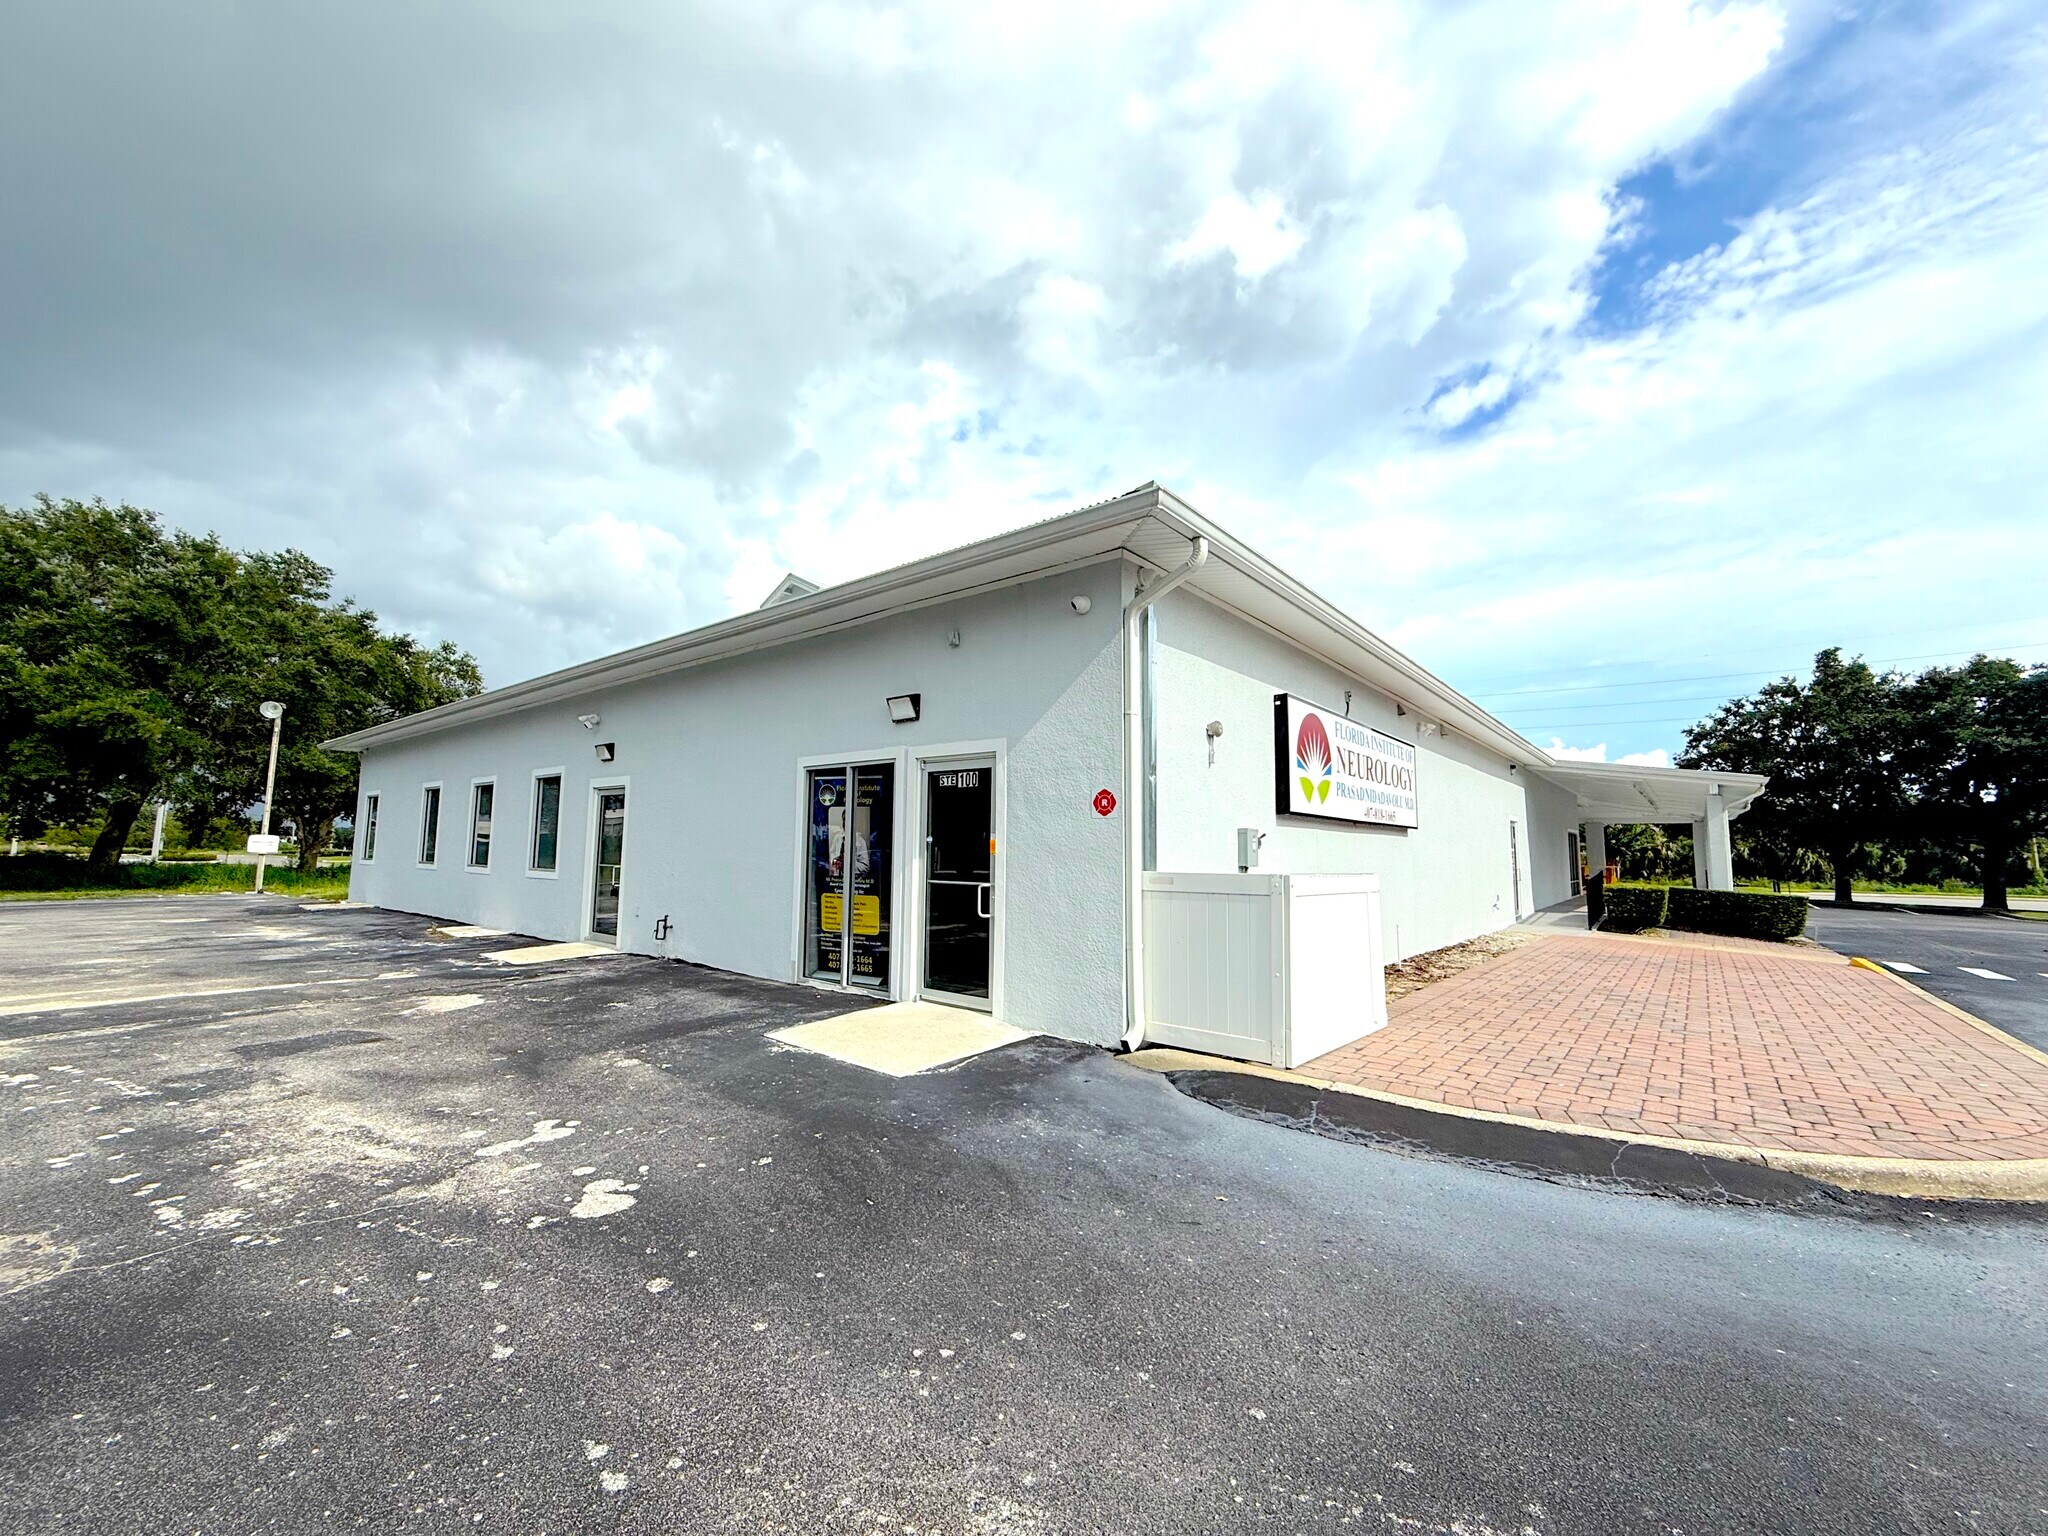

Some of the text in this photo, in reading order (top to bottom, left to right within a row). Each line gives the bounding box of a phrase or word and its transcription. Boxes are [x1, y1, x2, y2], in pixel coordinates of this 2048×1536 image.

[1335, 721, 1413, 763] FLORIDA INSTITUTE OF
[1336, 746, 1414, 792] NEUROLOGY
[940, 772, 978, 787] STE 100
[1336, 781, 1365, 801] PRASAD
[1101, 799, 1108, 807] R
